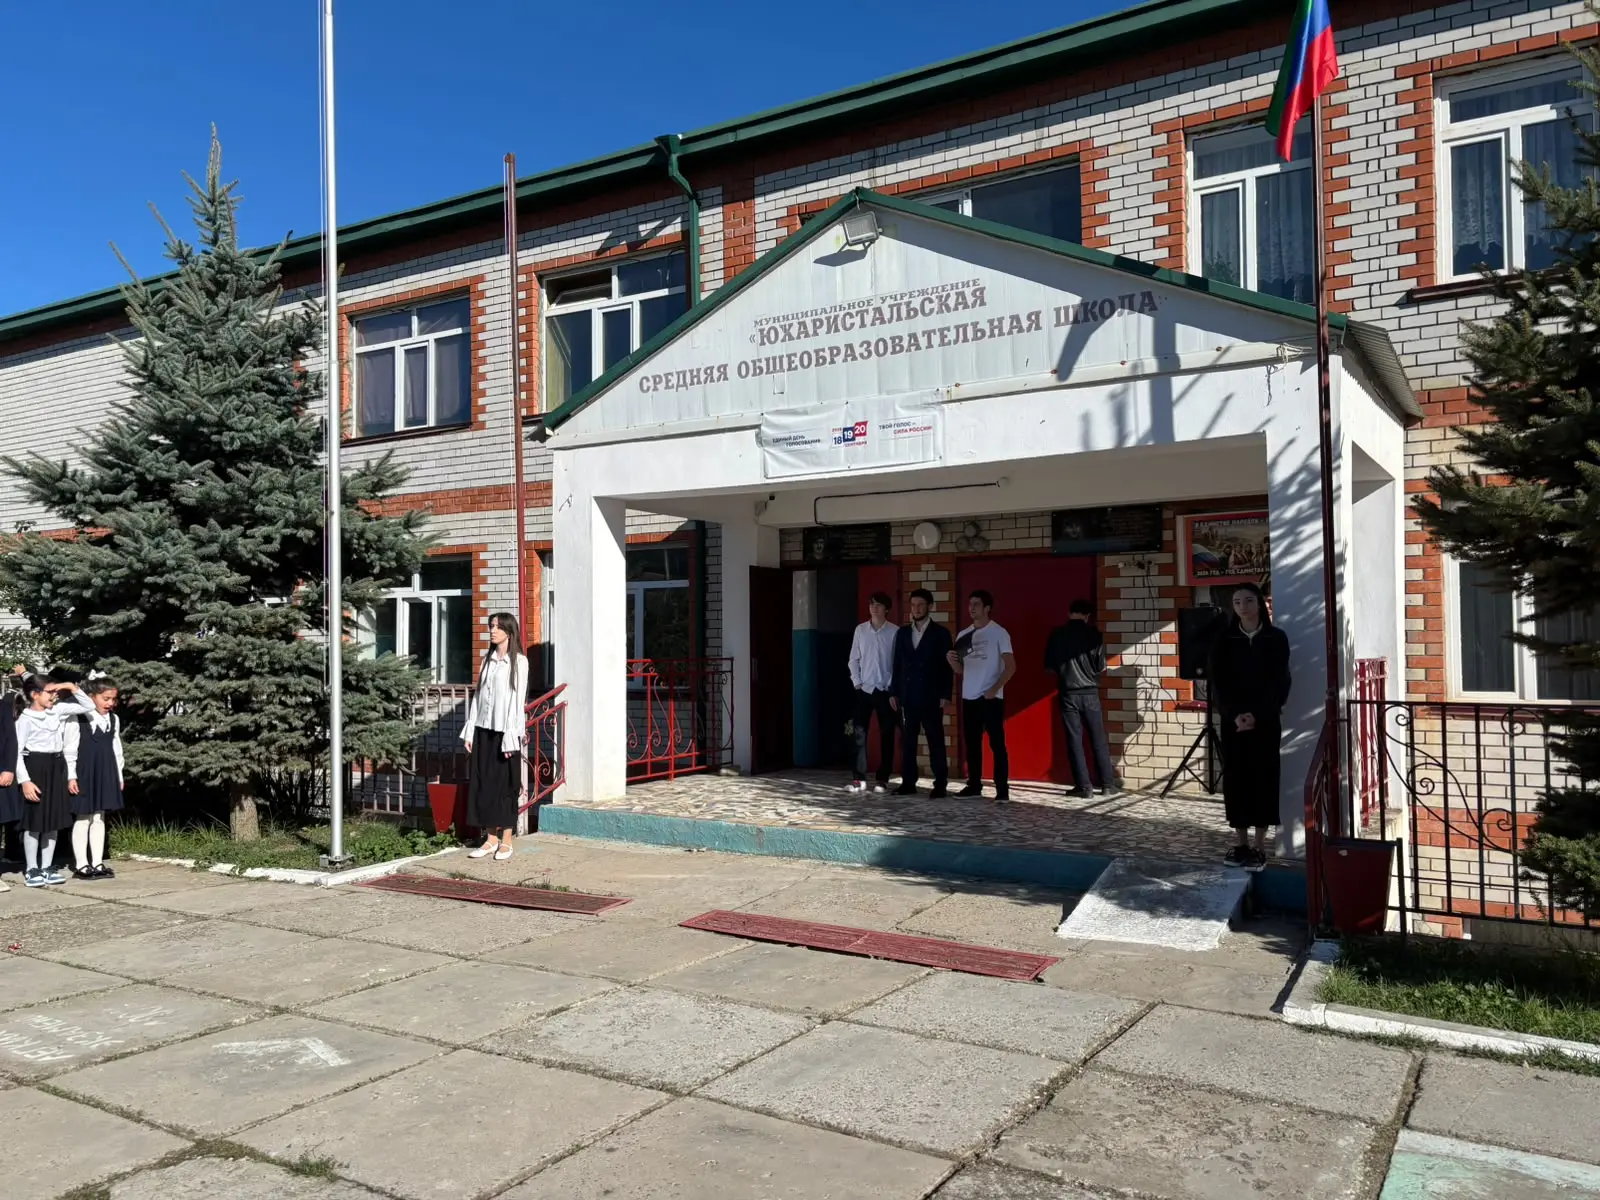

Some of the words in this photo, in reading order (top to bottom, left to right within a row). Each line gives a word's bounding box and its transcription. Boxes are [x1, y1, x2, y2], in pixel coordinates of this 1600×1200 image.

[754, 298, 874, 327] МУНИЦИПАЛЬНОЕ
[880, 278, 981, 304] УЧРЕЖДЕНИЕ
[639, 363, 729, 393] СРЕДНЯЯ
[1053, 290, 1158, 328] ШКОЛА
[879, 422, 893, 430] ТВОЙ
[893, 420, 911, 429] ГОЛОС
[894, 427, 908, 435] СИЛА
[792, 434, 805, 443] ДЕНЬ
[834, 436, 842, 445] 18
[844, 430, 853, 440] 19
[855, 424, 866, 435] 20
